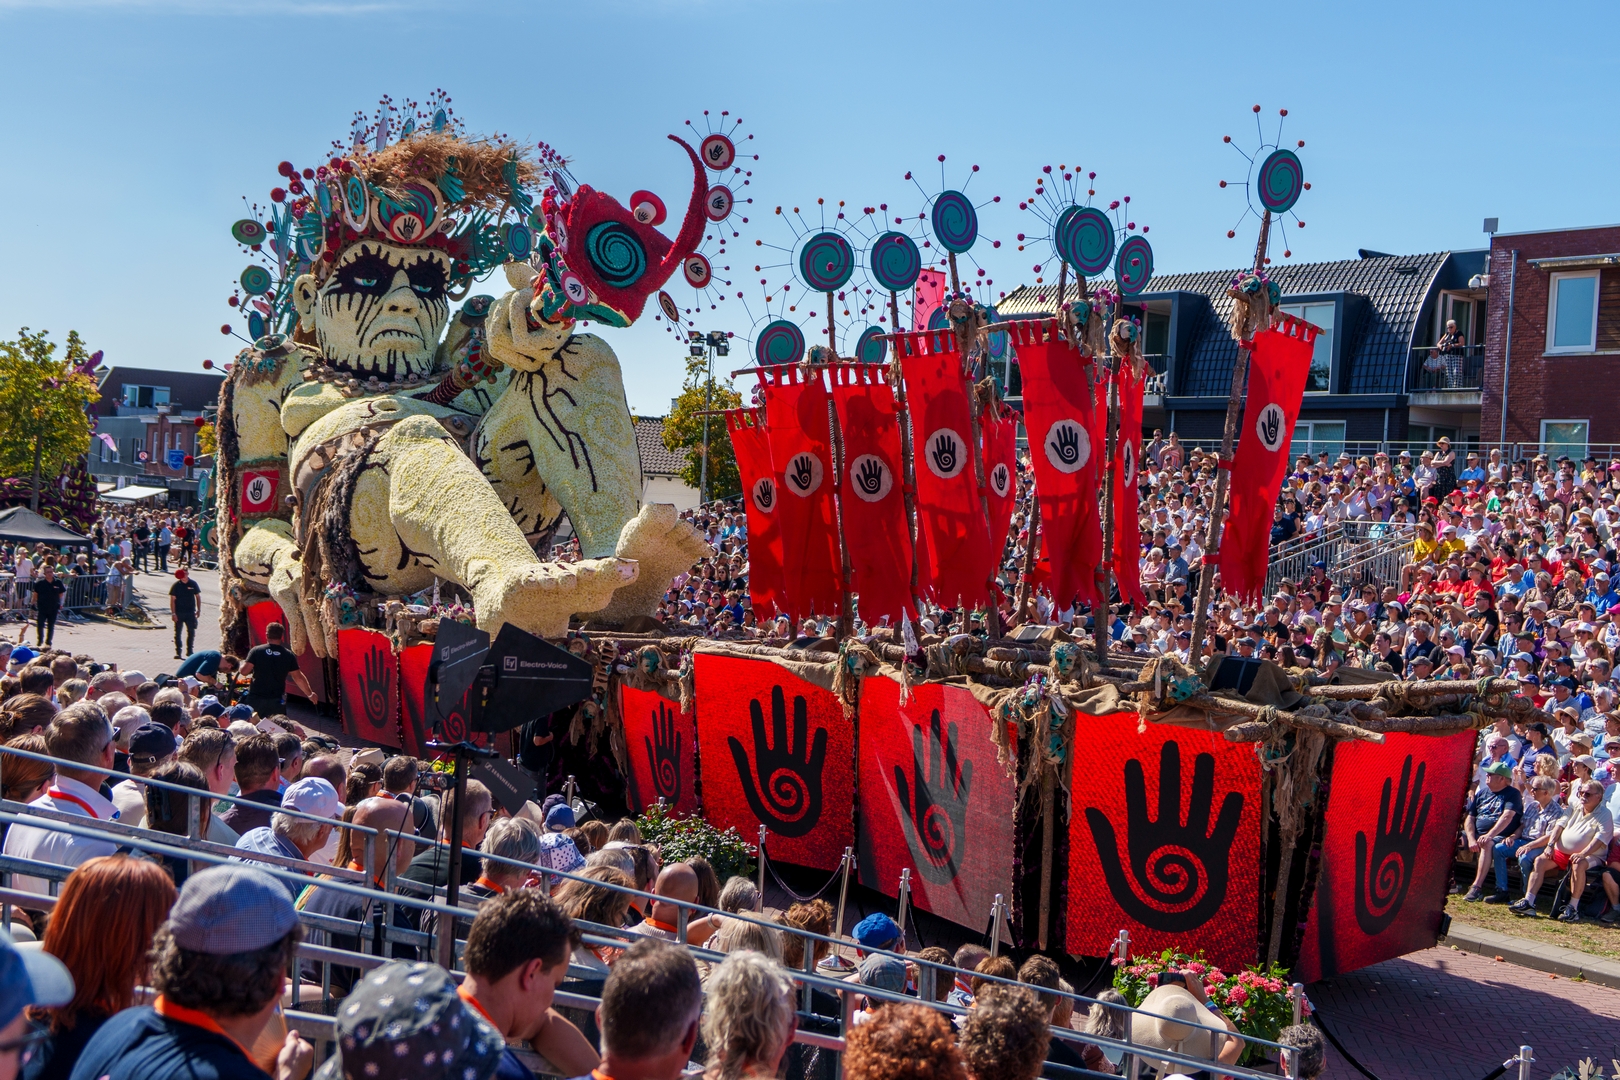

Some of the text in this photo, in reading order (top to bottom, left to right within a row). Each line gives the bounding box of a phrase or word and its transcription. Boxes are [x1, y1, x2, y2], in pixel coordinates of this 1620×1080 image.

[450, 639, 477, 654] Electro-Voice
[520, 661, 568, 669] Electro-Voice
[491, 768, 518, 794] SENNHEISER
